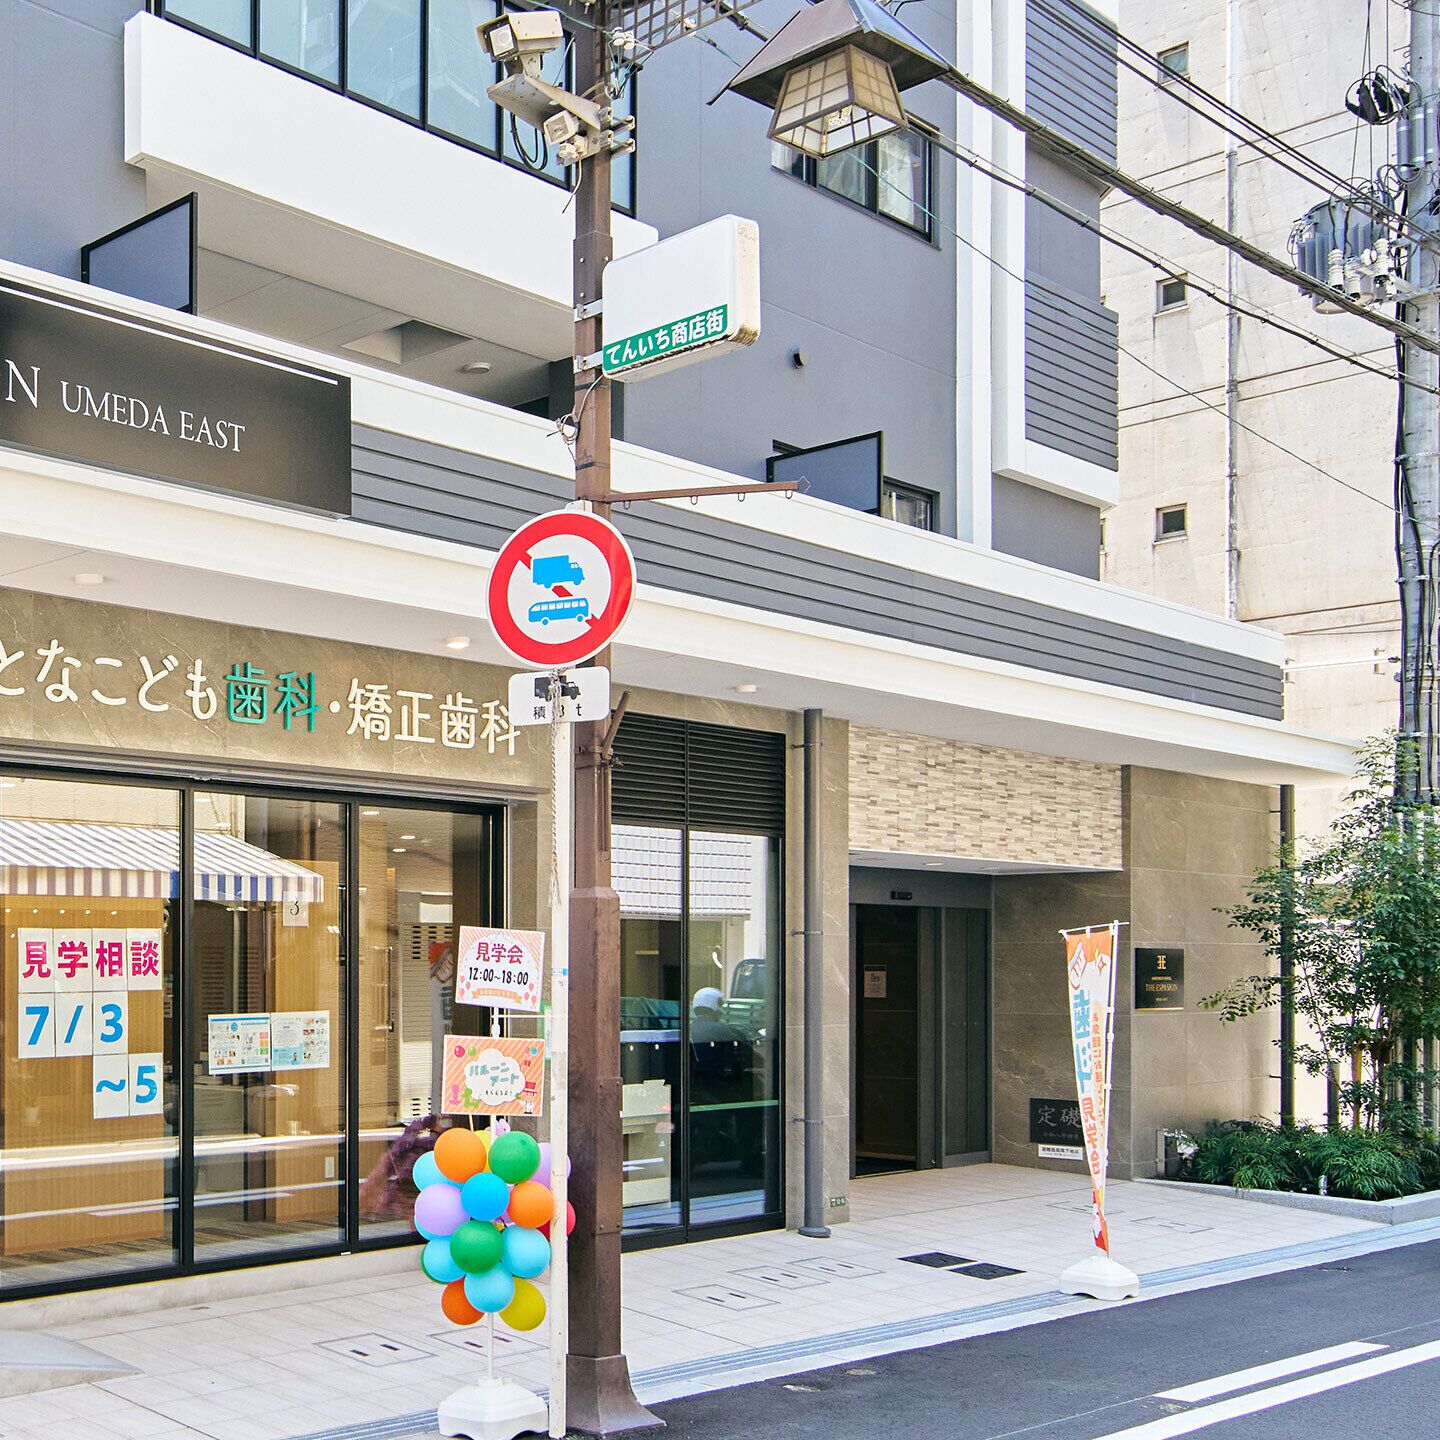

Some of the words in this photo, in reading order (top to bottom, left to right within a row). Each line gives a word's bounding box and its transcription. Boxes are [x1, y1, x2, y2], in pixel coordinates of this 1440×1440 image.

[606, 308, 724, 365] てんいち商店街
[60, 380, 171, 436] UMEDA
[178, 410, 246, 453] EAST
[532, 705, 547, 720] 積
[575, 703, 582, 717] t
[21, 940, 161, 980] 見学相談
[475, 941, 524, 965] 見学会
[25, 1003, 125, 1046] 7/3
[469, 1062, 510, 1077] バルーン
[490, 1073, 520, 1087] アート
[1037, 1105, 1082, 1128] 定礎
